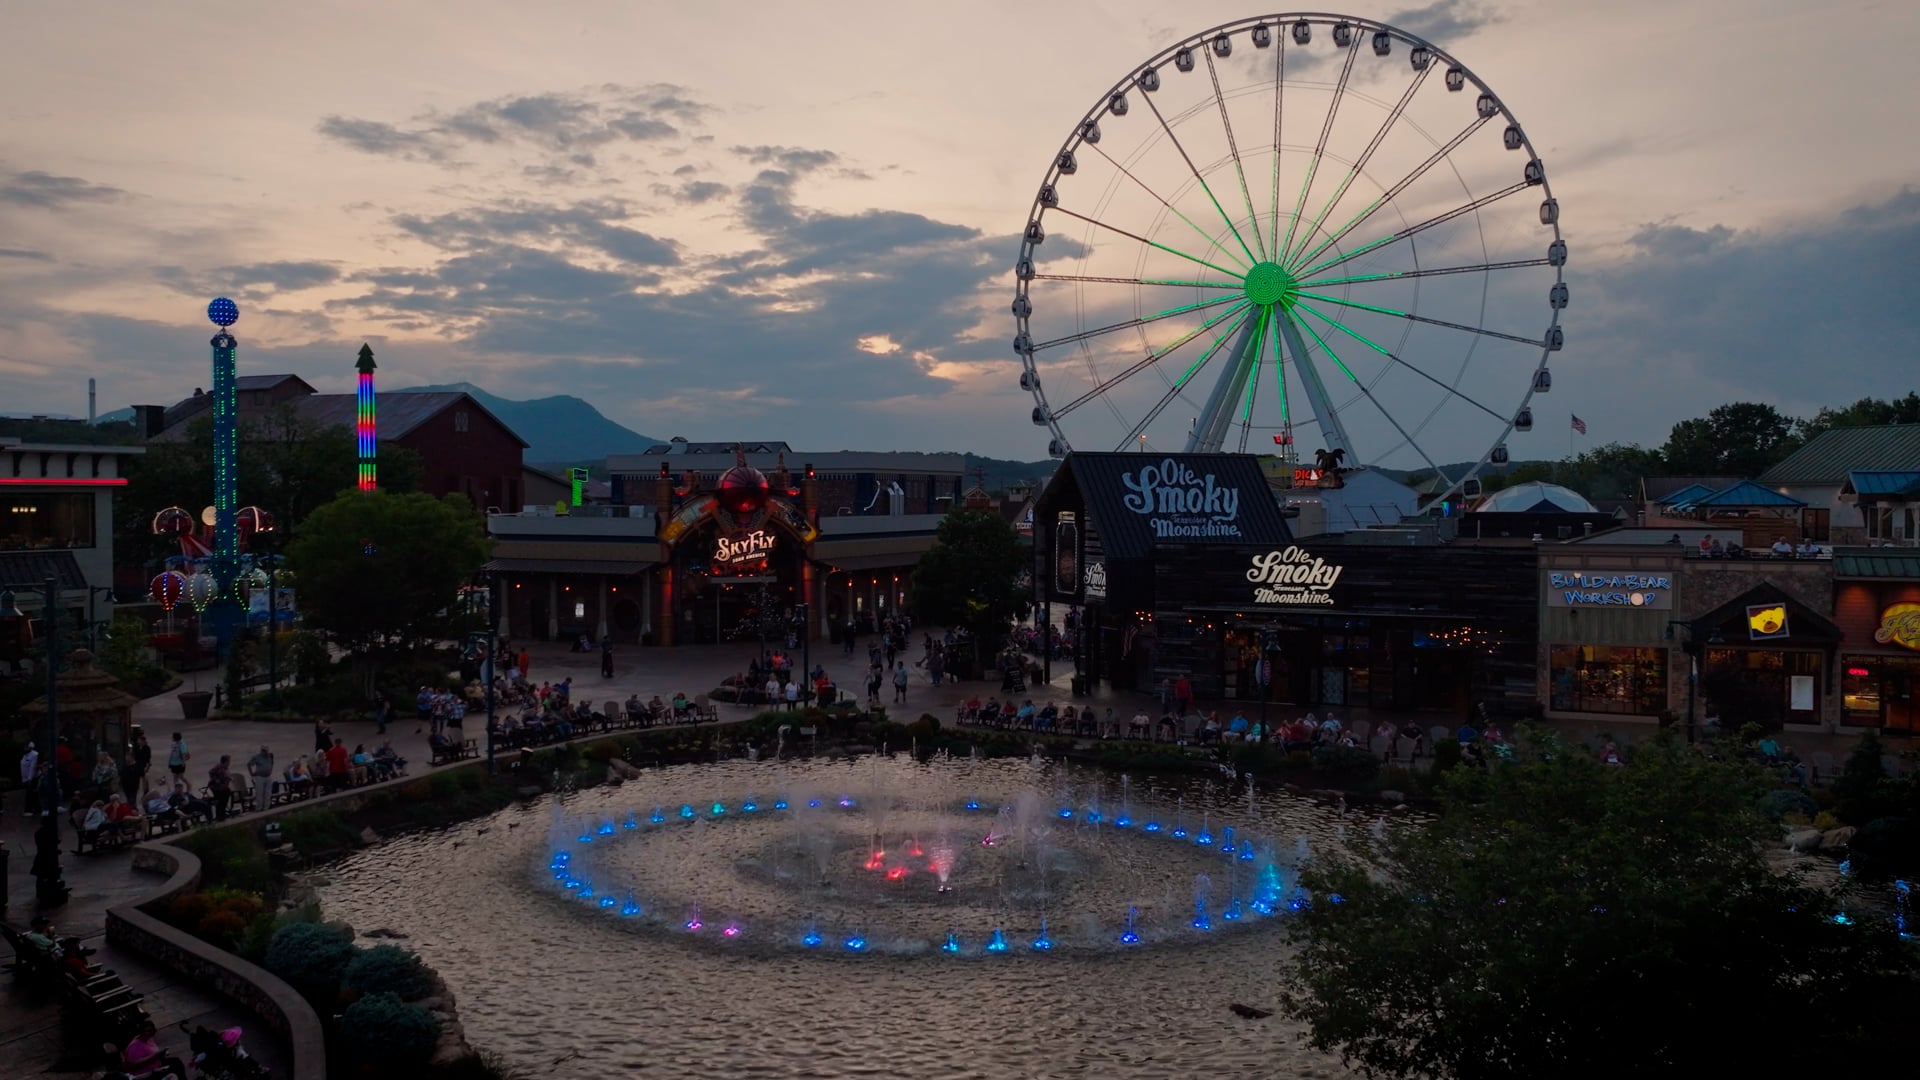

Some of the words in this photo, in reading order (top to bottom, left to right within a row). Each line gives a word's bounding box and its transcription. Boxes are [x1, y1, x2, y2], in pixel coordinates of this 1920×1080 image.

[1161, 458, 1204, 487] Ole
[1122, 465, 1239, 521] Smoky
[1150, 518, 1241, 537] Moonshine
[1283, 545, 1314, 565] Ole
[1246, 551, 1343, 590] Smoky
[1254, 588, 1334, 605] Moonshine
[1847, 668, 1869, 676] OPEN
